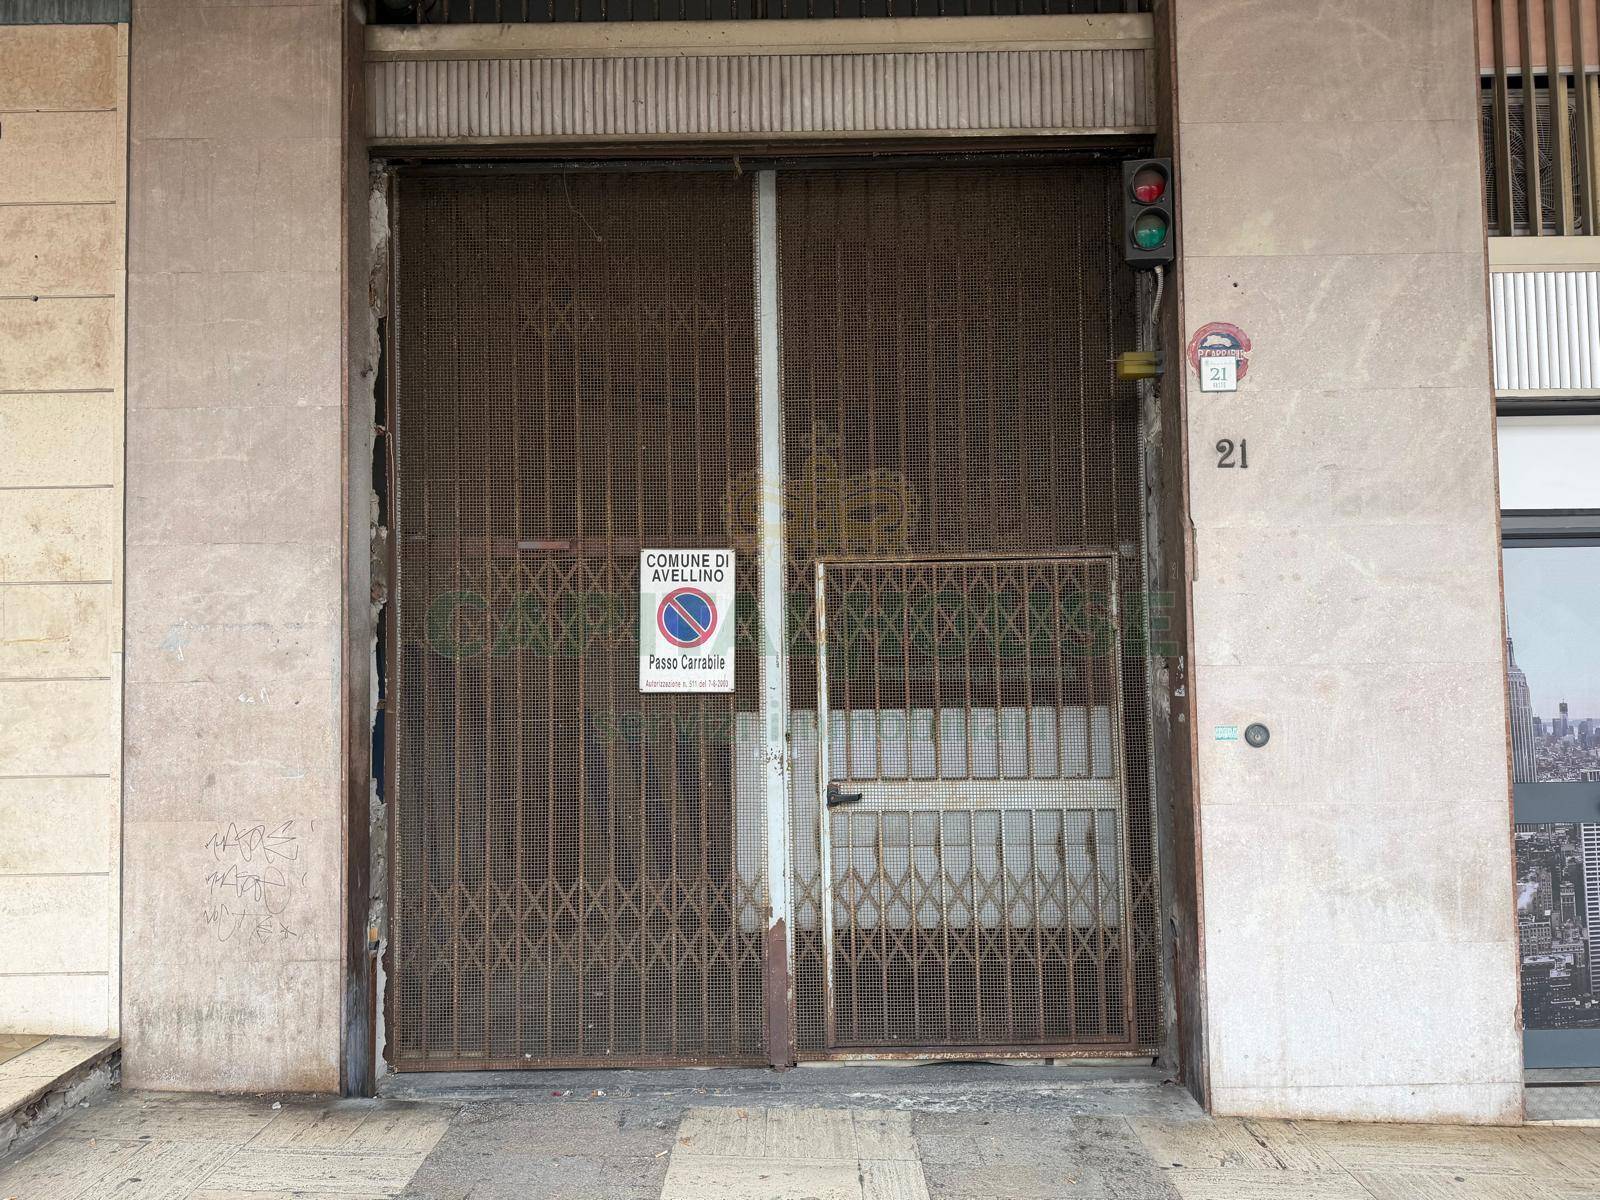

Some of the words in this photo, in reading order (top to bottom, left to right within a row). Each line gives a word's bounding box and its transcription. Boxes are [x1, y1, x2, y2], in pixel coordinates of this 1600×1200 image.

[1209, 367, 1228, 381] 21
[1215, 438, 1249, 469] 21
[646, 553, 710, 568] COMUNE
[715, 553, 729, 568] DI
[651, 569, 724, 582] AVELLINO
[649, 655, 678, 670] Passo
[681, 655, 726, 670] Carrabile
[645, 679, 681, 688] Autorizzazione
[699, 679, 707, 688] del
